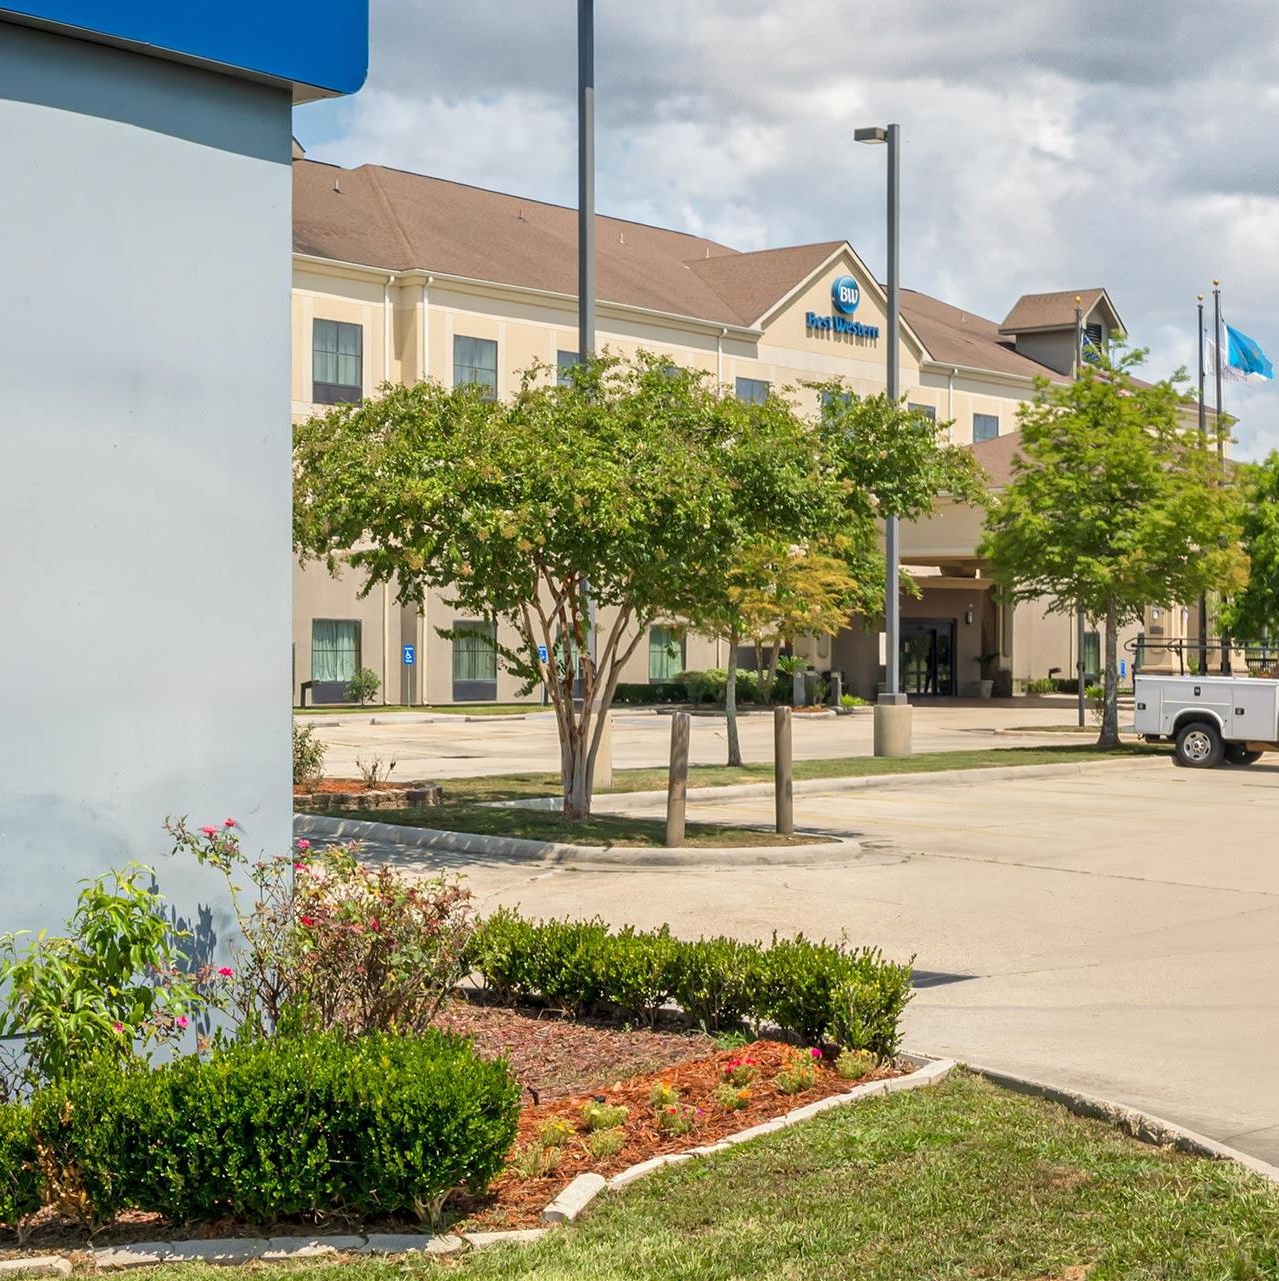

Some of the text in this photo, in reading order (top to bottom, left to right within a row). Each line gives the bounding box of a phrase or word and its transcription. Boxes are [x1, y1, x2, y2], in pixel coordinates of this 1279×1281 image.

[840, 286, 858, 304] BW
[806, 312, 879, 338] Best Western
